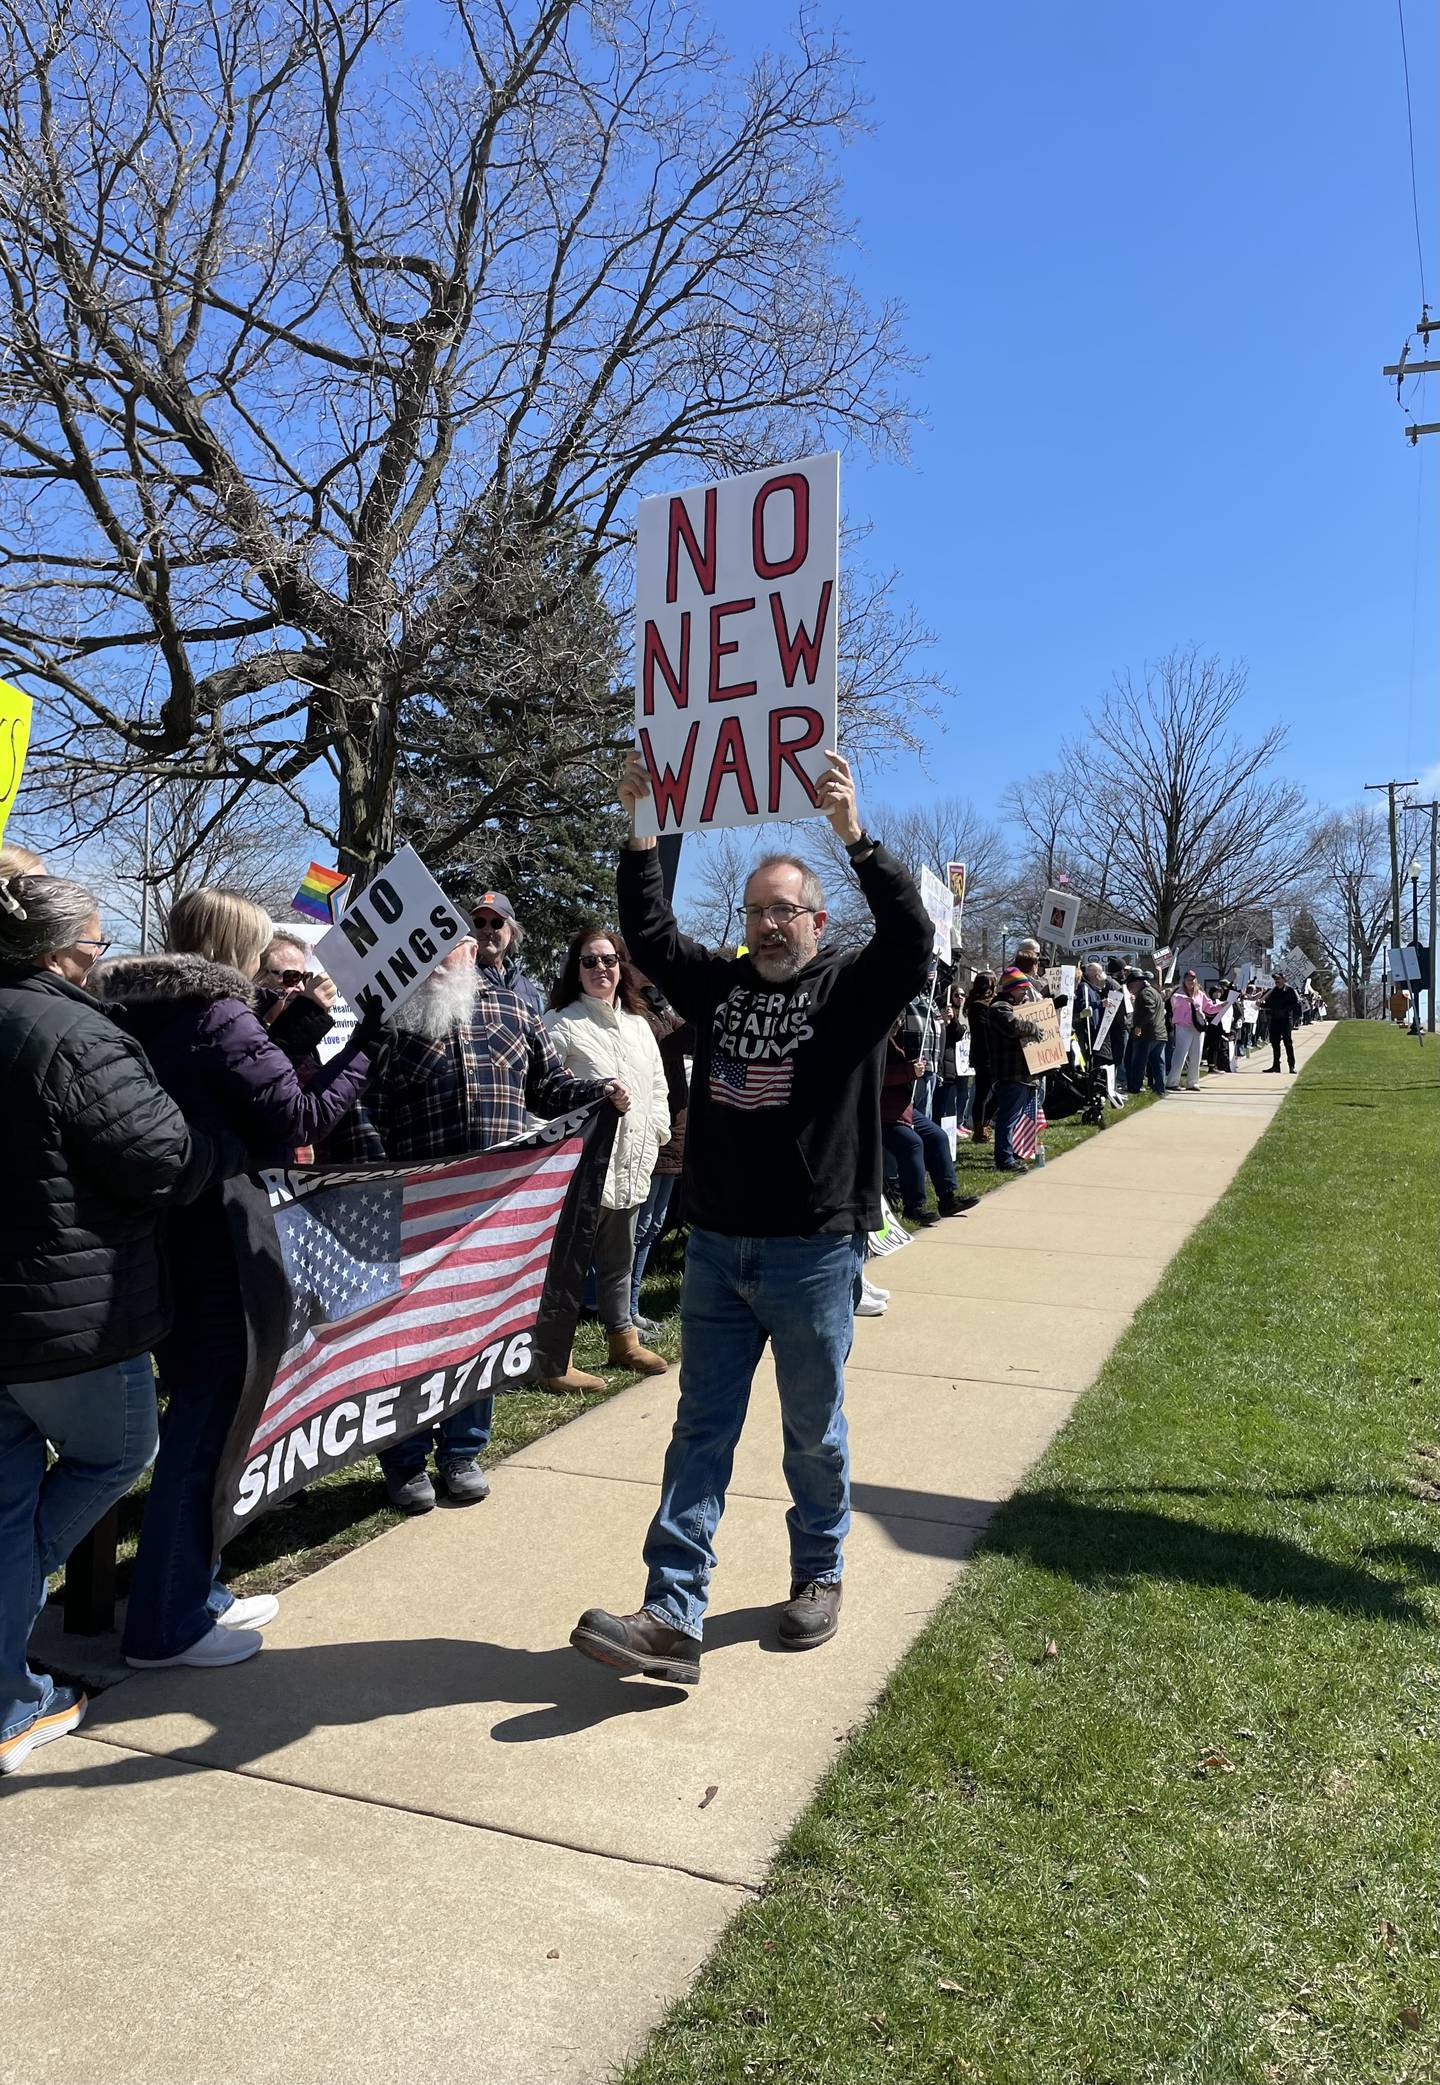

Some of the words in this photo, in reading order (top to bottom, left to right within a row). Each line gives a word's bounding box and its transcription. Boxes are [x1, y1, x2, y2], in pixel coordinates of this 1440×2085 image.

[666, 472, 810, 603] NO
[643, 580, 833, 716] NEW
[639, 706, 824, 831] WAR
[339, 878, 404, 959] NO
[354, 905, 458, 1016] KINGS
[1072, 934, 1111, 948] CENTRAL
[1114, 933, 1150, 946] SQUARE
[1037, 1042, 1063, 1066] NOW!
[233, 1386, 401, 1516] SINCE
[417, 1332, 533, 1427] 1776
